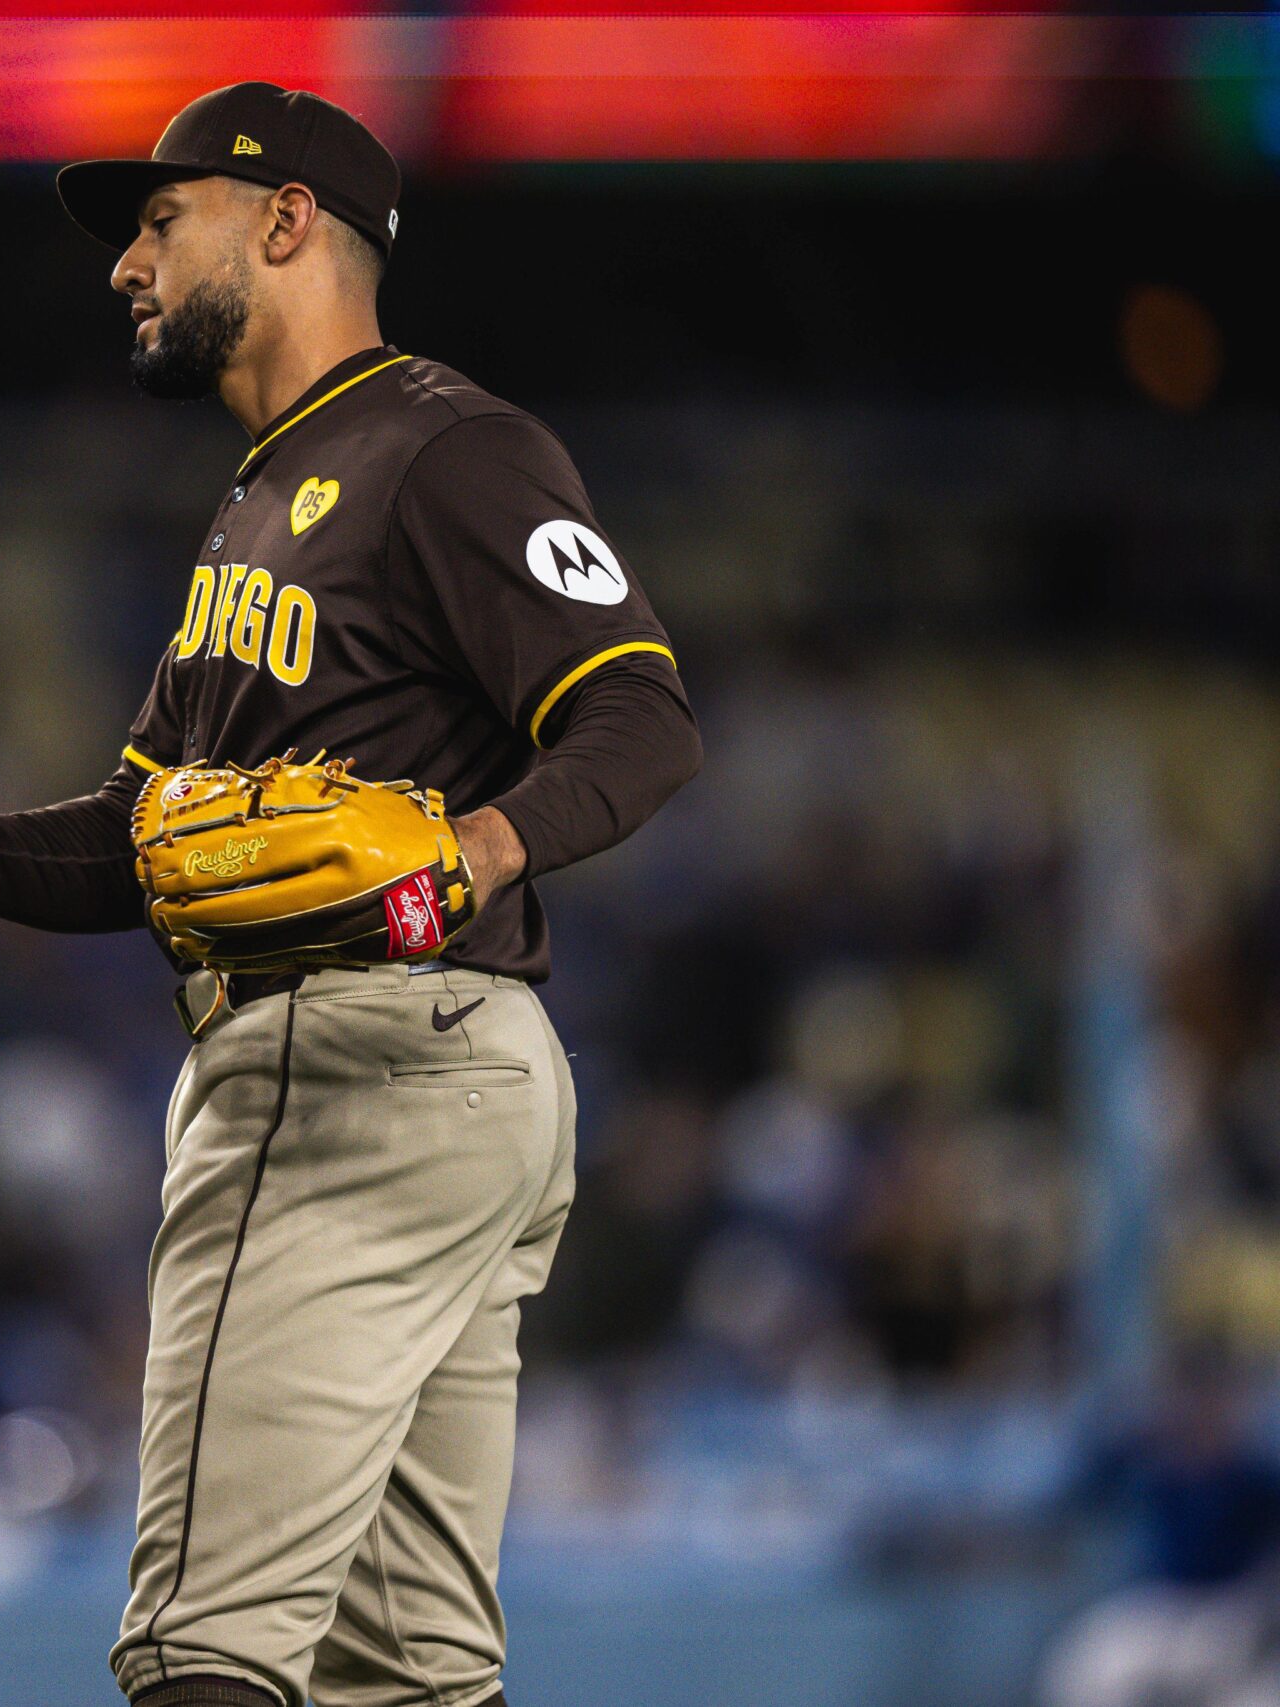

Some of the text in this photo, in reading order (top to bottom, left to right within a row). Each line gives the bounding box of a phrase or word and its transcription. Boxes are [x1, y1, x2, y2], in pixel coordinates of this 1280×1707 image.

[296, 490, 326, 520] PS
[184, 836, 269, 877] Rawlings
[399, 890, 426, 947] Rawlings
